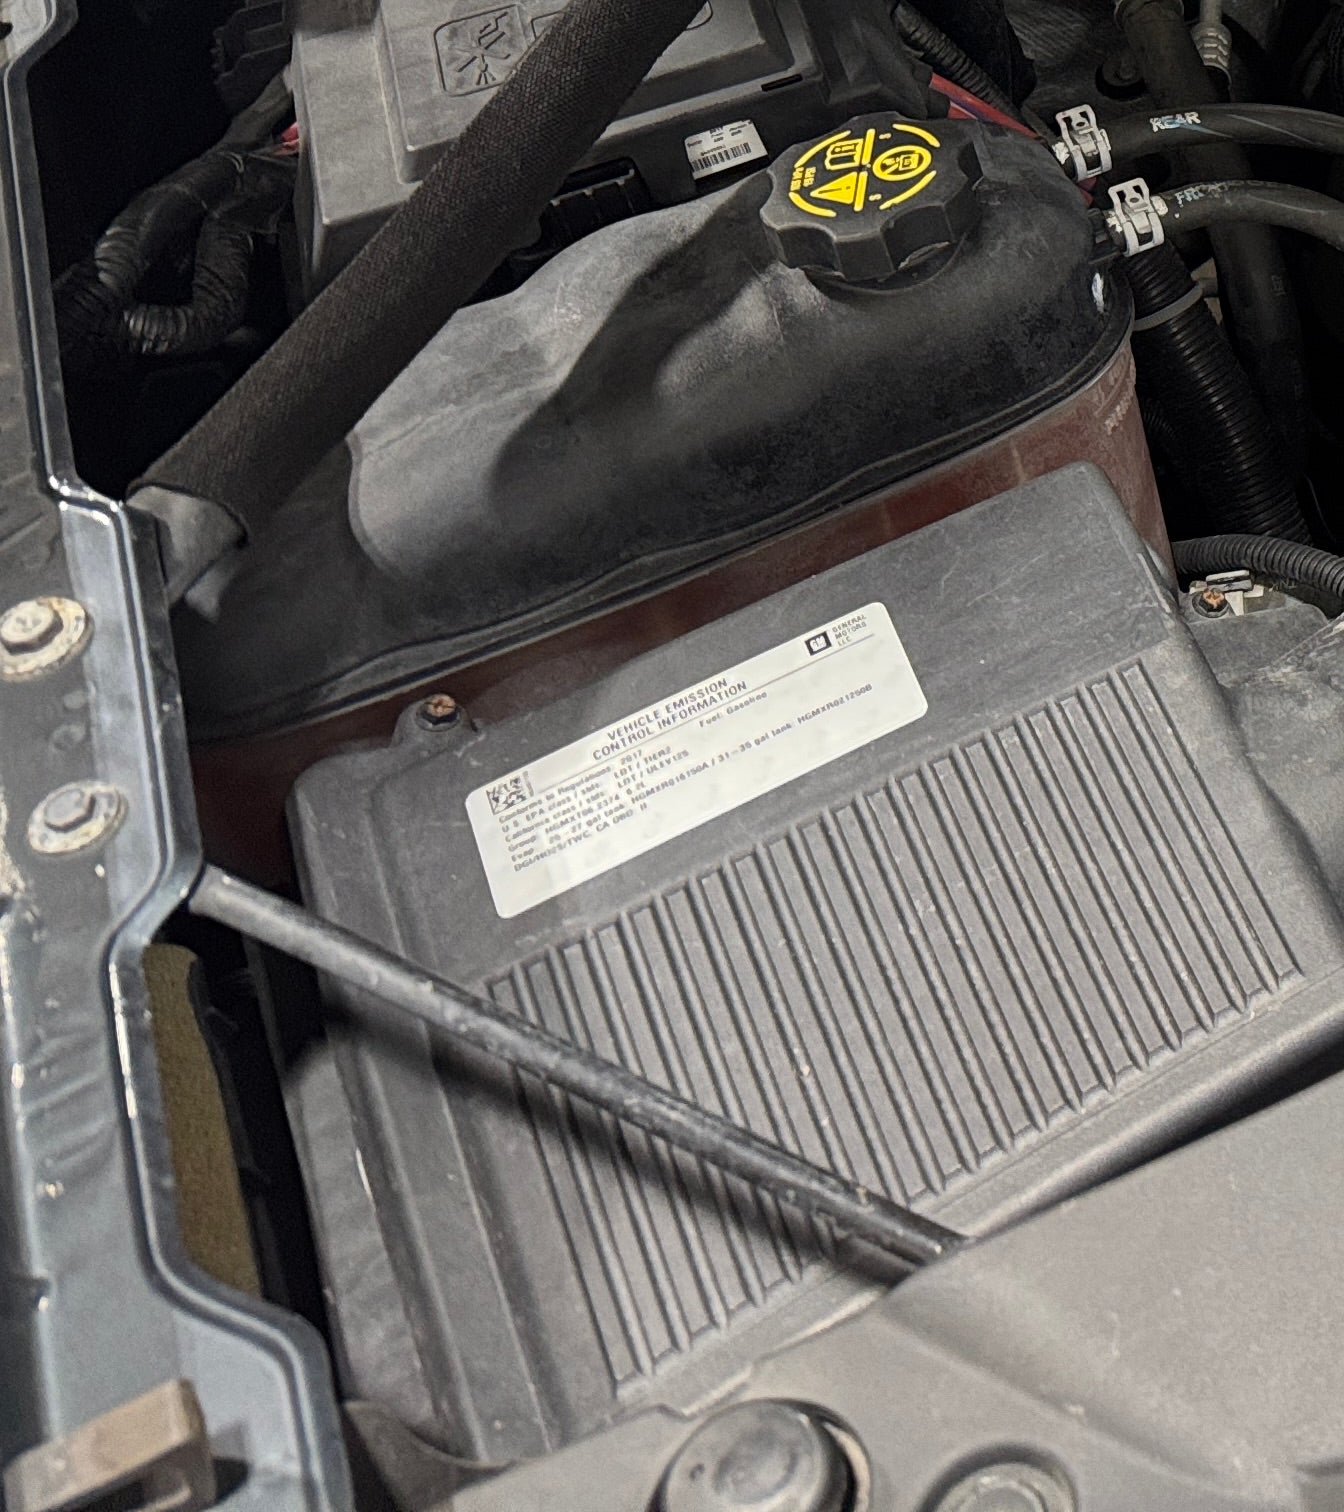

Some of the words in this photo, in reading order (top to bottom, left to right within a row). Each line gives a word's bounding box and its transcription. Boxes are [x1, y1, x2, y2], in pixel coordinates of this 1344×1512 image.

[1150, 111, 1201, 133] REAR
[831, 613, 866, 633] GENERAL
[834, 620, 866, 640] MOTORS
[807, 632, 830, 653] GM
[837, 636, 851, 646] LLC
[607, 709, 660, 741] VEHICLE
[664, 678, 727, 714] EMISSION
[725, 690, 767, 715] Gasoline
[592, 725, 653, 761] CONTROL
[657, 680, 747, 730] INFORMATION
[498, 798, 542, 823] Conforms
[545, 792, 554, 801] to
[619, 749, 643, 765] 2017
[585, 812, 601, 827] gal
[753, 731, 770, 746] gal
[525, 807, 544, 822] EPA
[546, 795, 571, 811] class
[613, 764, 633, 780] LDT
[504, 816, 550, 843] California
[552, 804, 576, 820] class
[616, 773, 637, 789] LDT
[595, 820, 610, 832] CA
